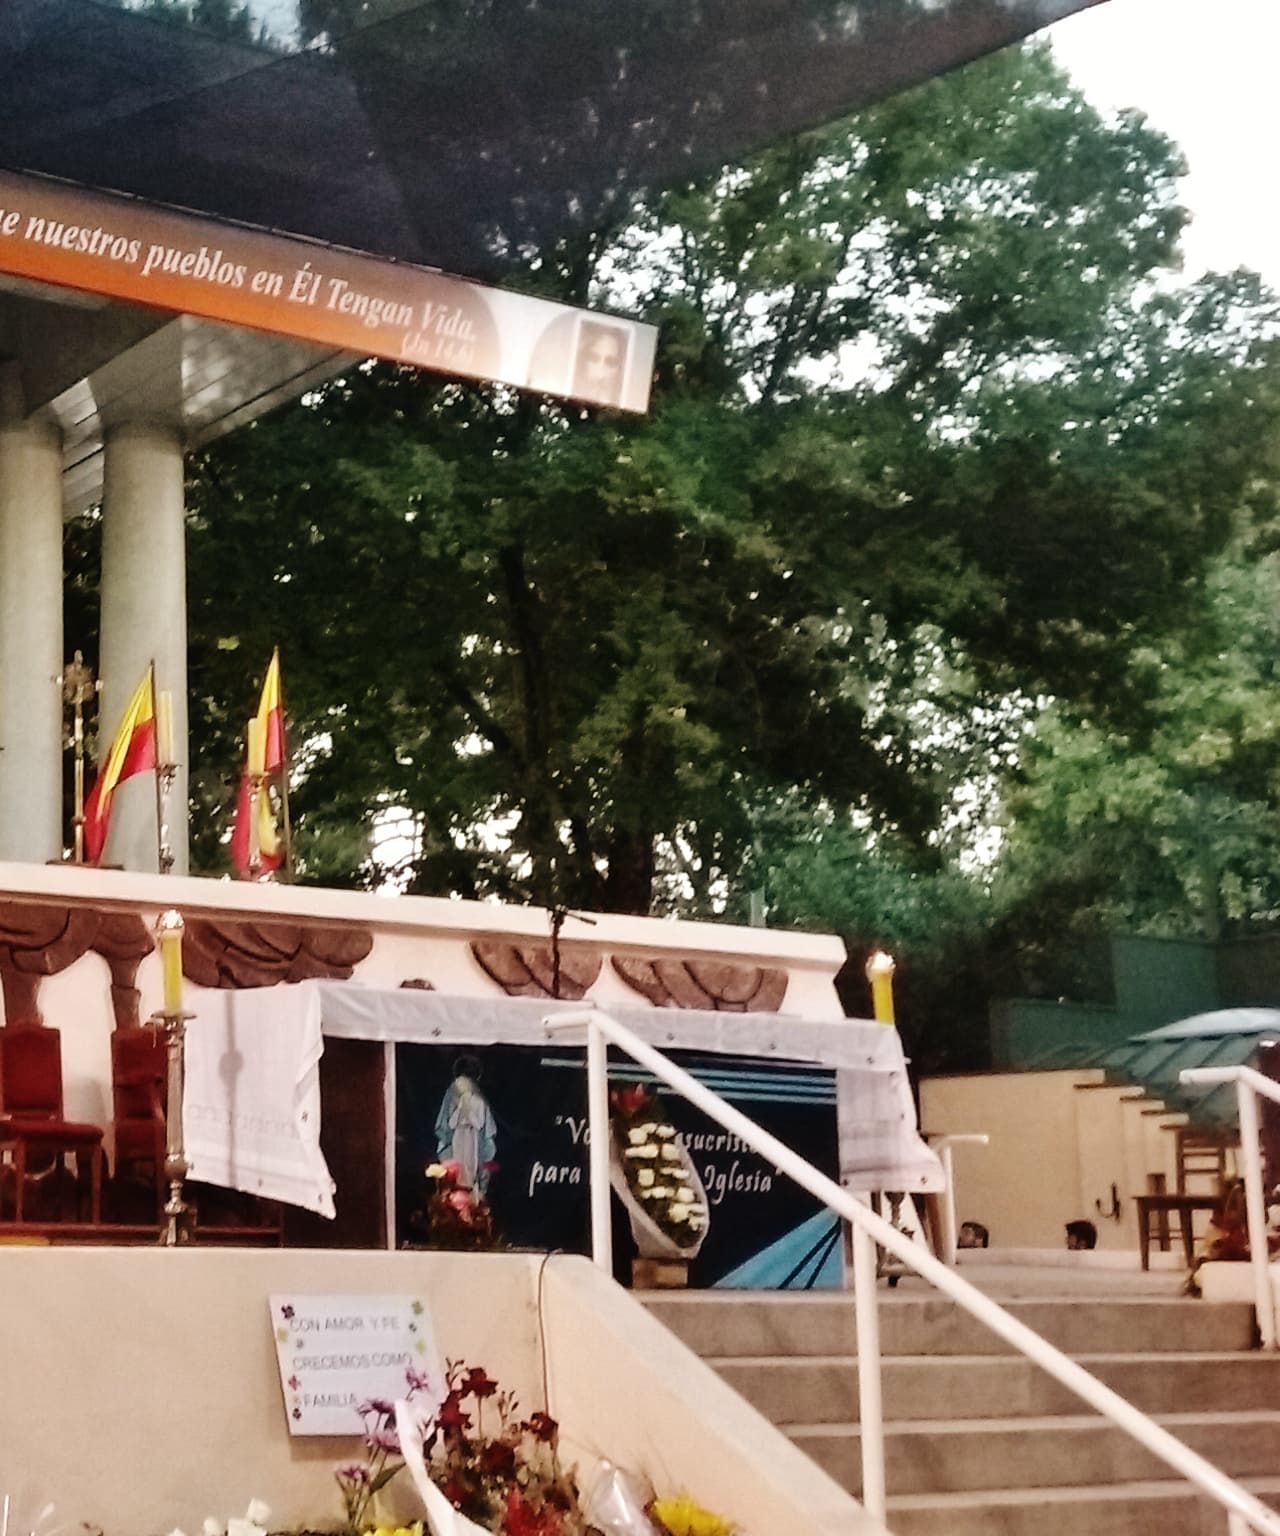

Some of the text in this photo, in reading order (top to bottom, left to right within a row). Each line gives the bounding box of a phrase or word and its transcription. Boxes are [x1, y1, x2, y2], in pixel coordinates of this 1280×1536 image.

[25, 216, 141, 263] nuestros
[141, 244, 247, 289] pueblos
[251, 270, 284, 297] en
[289, 262, 322, 306] Él
[328, 278, 413, 327] Tengan
[529, 1161, 581, 1198] para
[290, 1317, 320, 1332] CON
[371, 1316, 380, 1330] Y
[382, 1315, 400, 1330] FE
[292, 1352, 413, 1370] CRECEMOS COMO
[303, 1393, 358, 1408] FAMILIA
